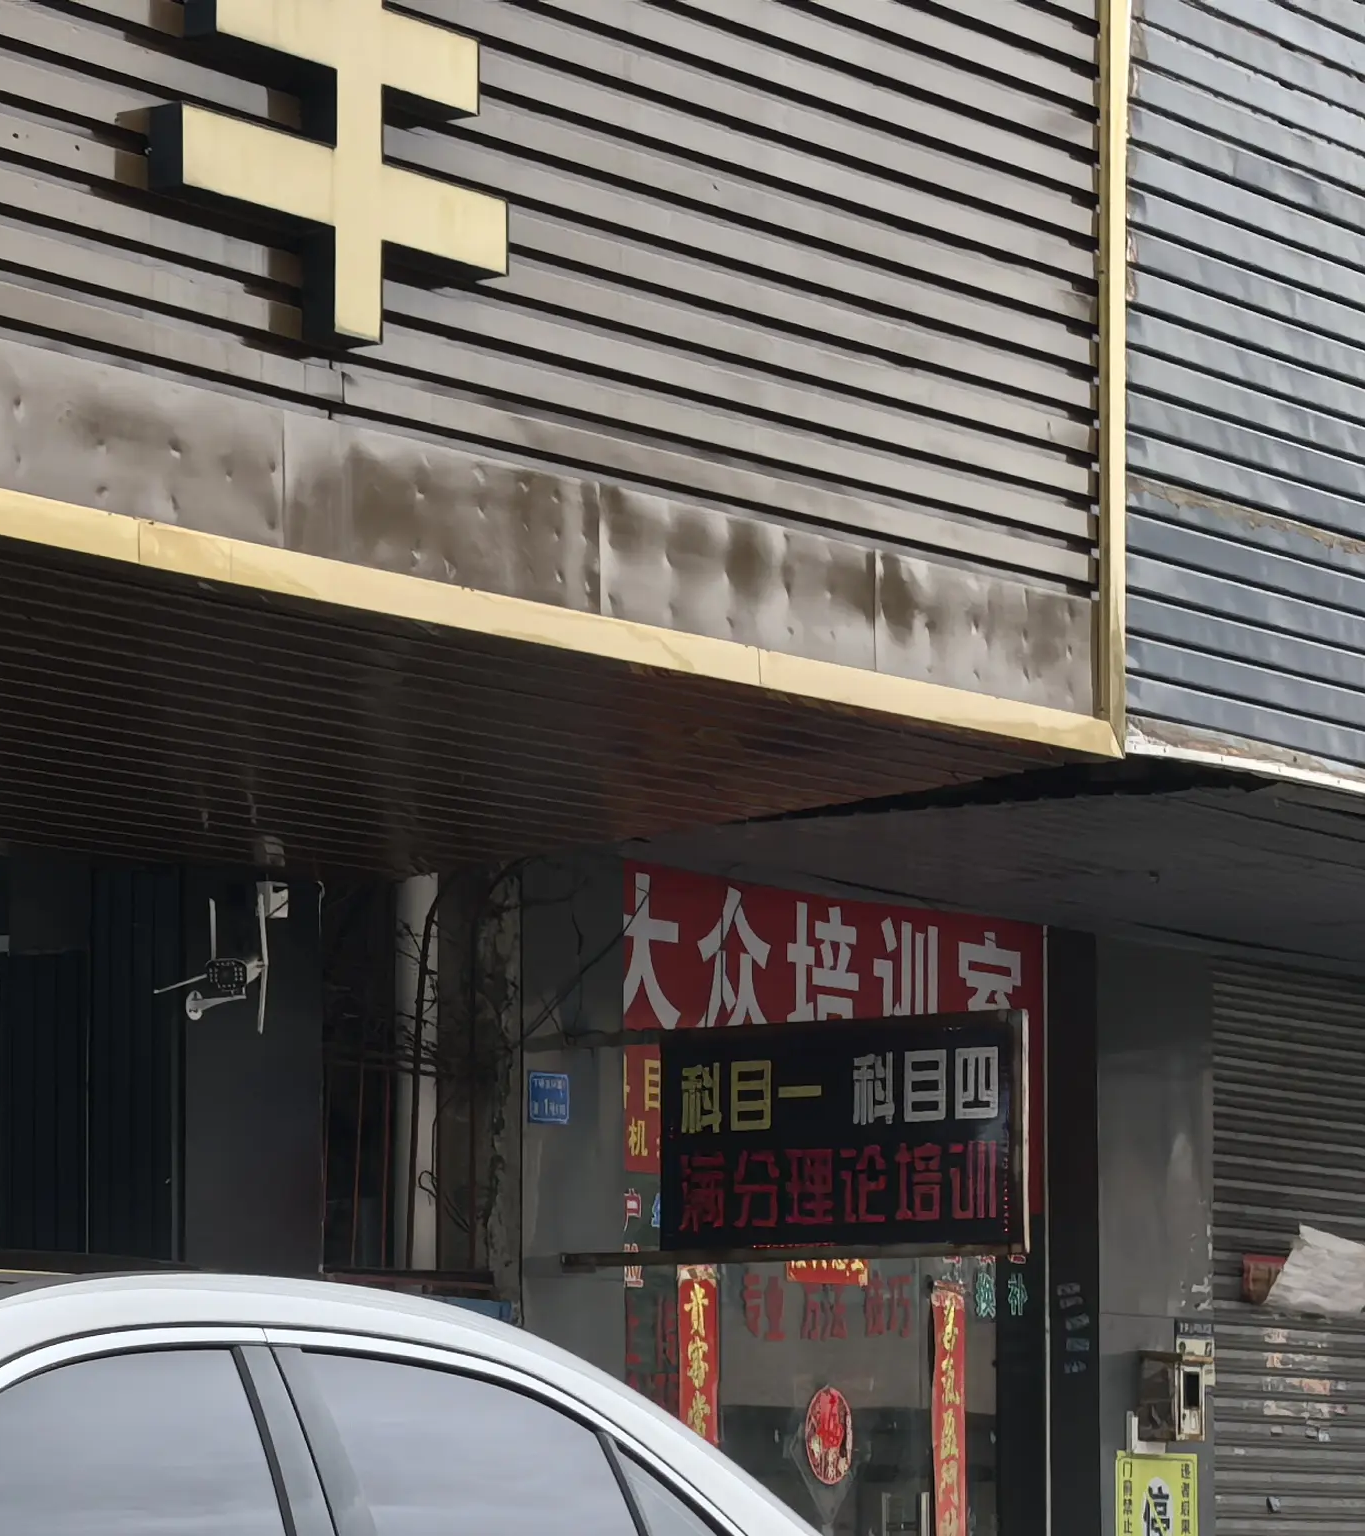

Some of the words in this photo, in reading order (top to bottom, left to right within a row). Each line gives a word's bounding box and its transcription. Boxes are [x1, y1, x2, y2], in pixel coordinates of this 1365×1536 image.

[681, 1061, 822, 1134] 科目一
[852, 1046, 999, 1125] 科目四
[678, 1140, 997, 1233] 满分理论培训
